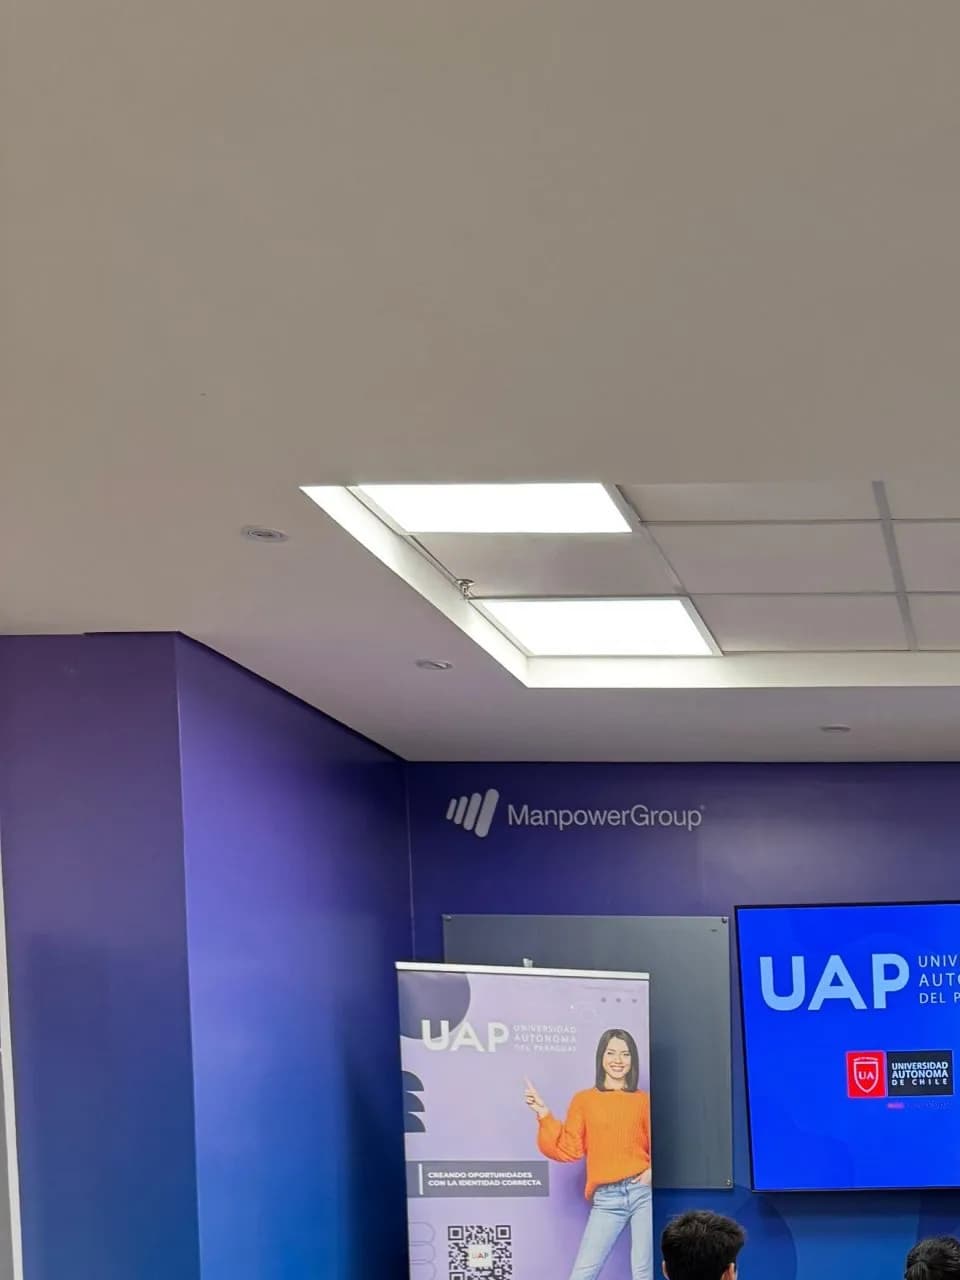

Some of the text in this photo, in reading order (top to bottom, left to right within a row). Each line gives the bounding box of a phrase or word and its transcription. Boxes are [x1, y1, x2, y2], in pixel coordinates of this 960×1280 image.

[508, 804, 702, 831] ManpowerGroup
[759, 953, 910, 1011] UAP
[919, 992, 946, 1004] DEL
[421, 1019, 510, 1053] UAP
[891, 1061, 949, 1070] UNIVERSIDAD
[858, 1071, 875, 1080] UA
[911, 1078, 948, 1086] CHILE
